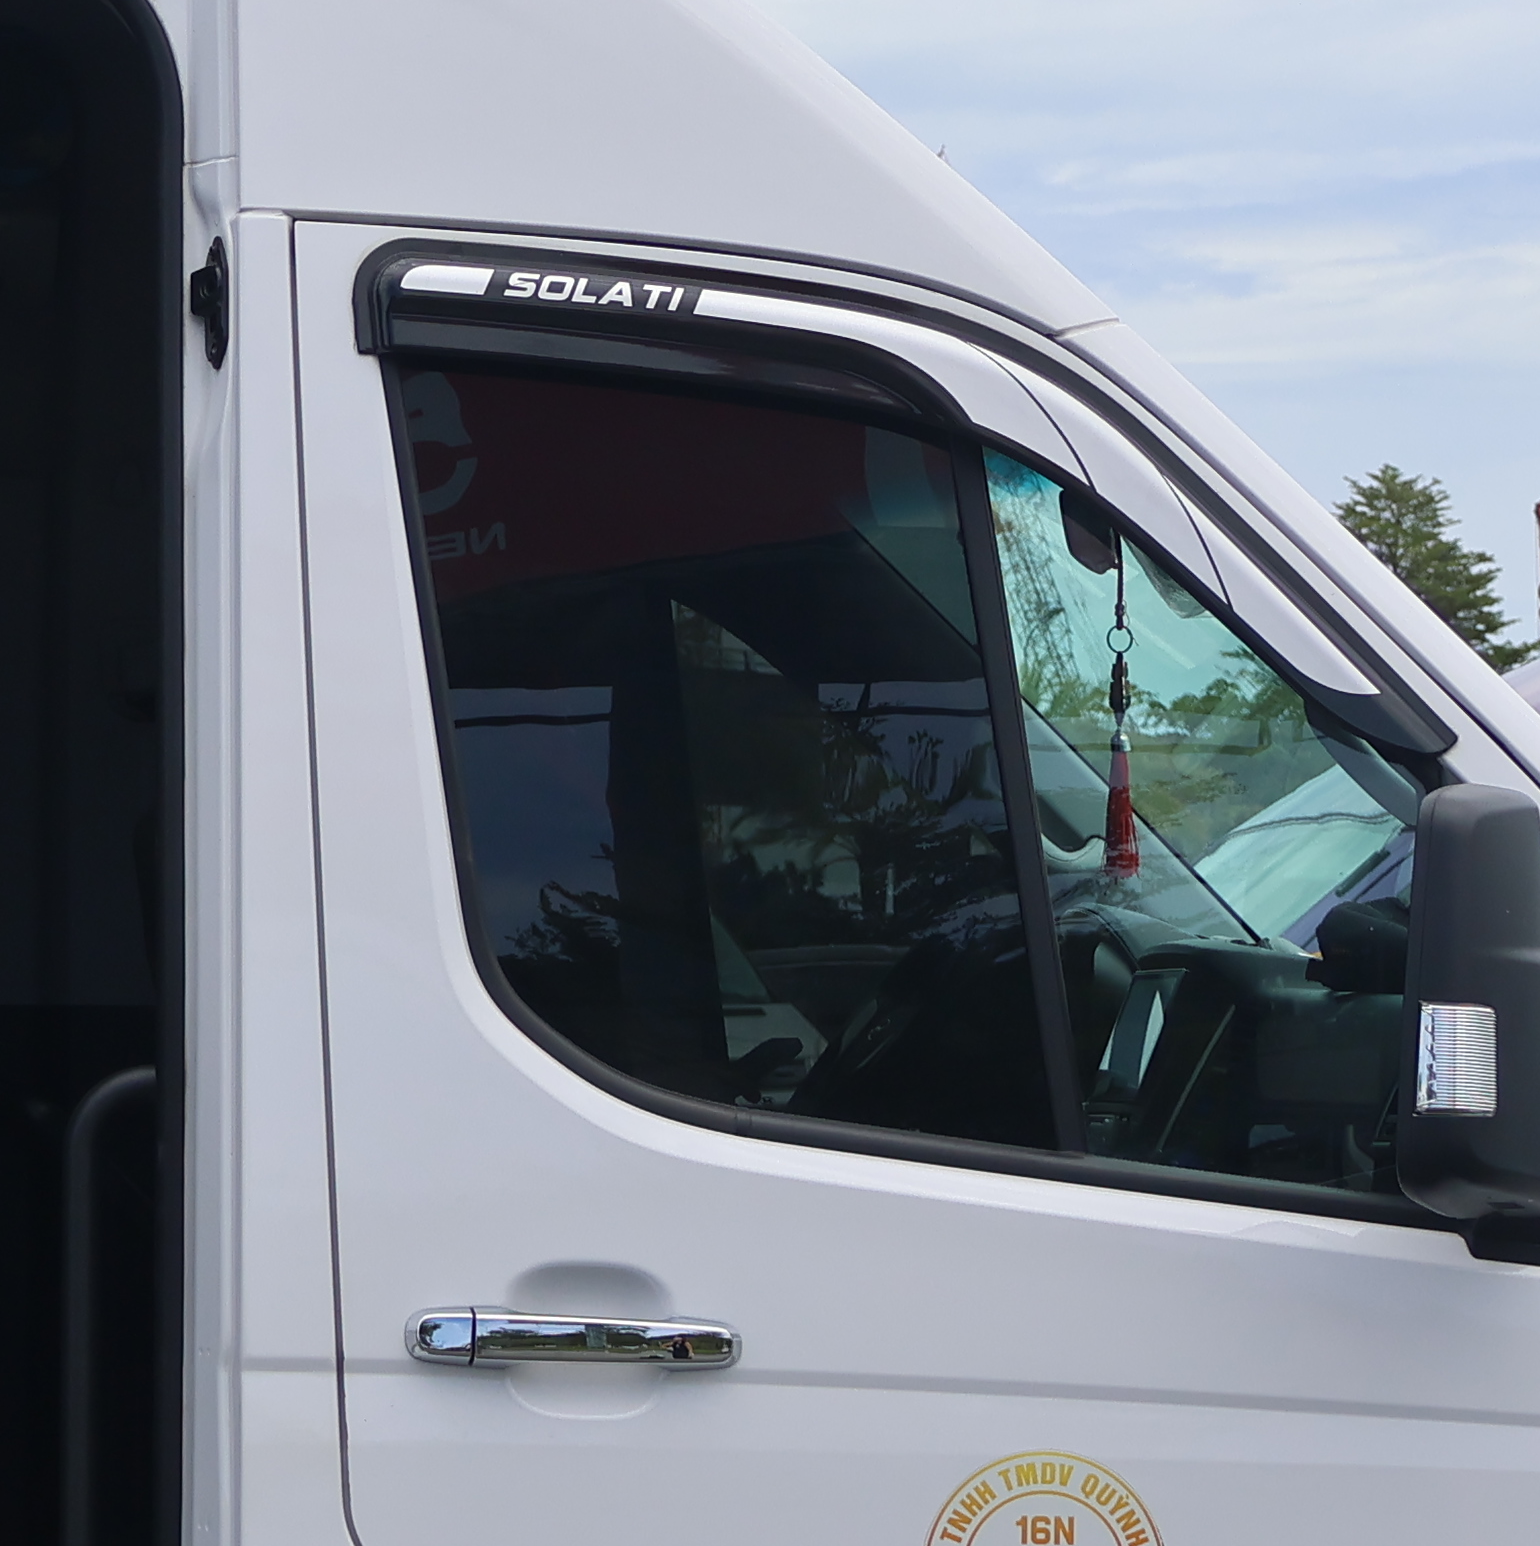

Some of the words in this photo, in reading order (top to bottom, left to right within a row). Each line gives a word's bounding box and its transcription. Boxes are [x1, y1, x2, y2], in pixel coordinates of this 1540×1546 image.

[503, 272, 685, 312] SOLATI
[941, 1480, 996, 1544] TNHH
[998, 1461, 1075, 1491] TMDV
[1015, 1515, 1075, 1546] 16N
